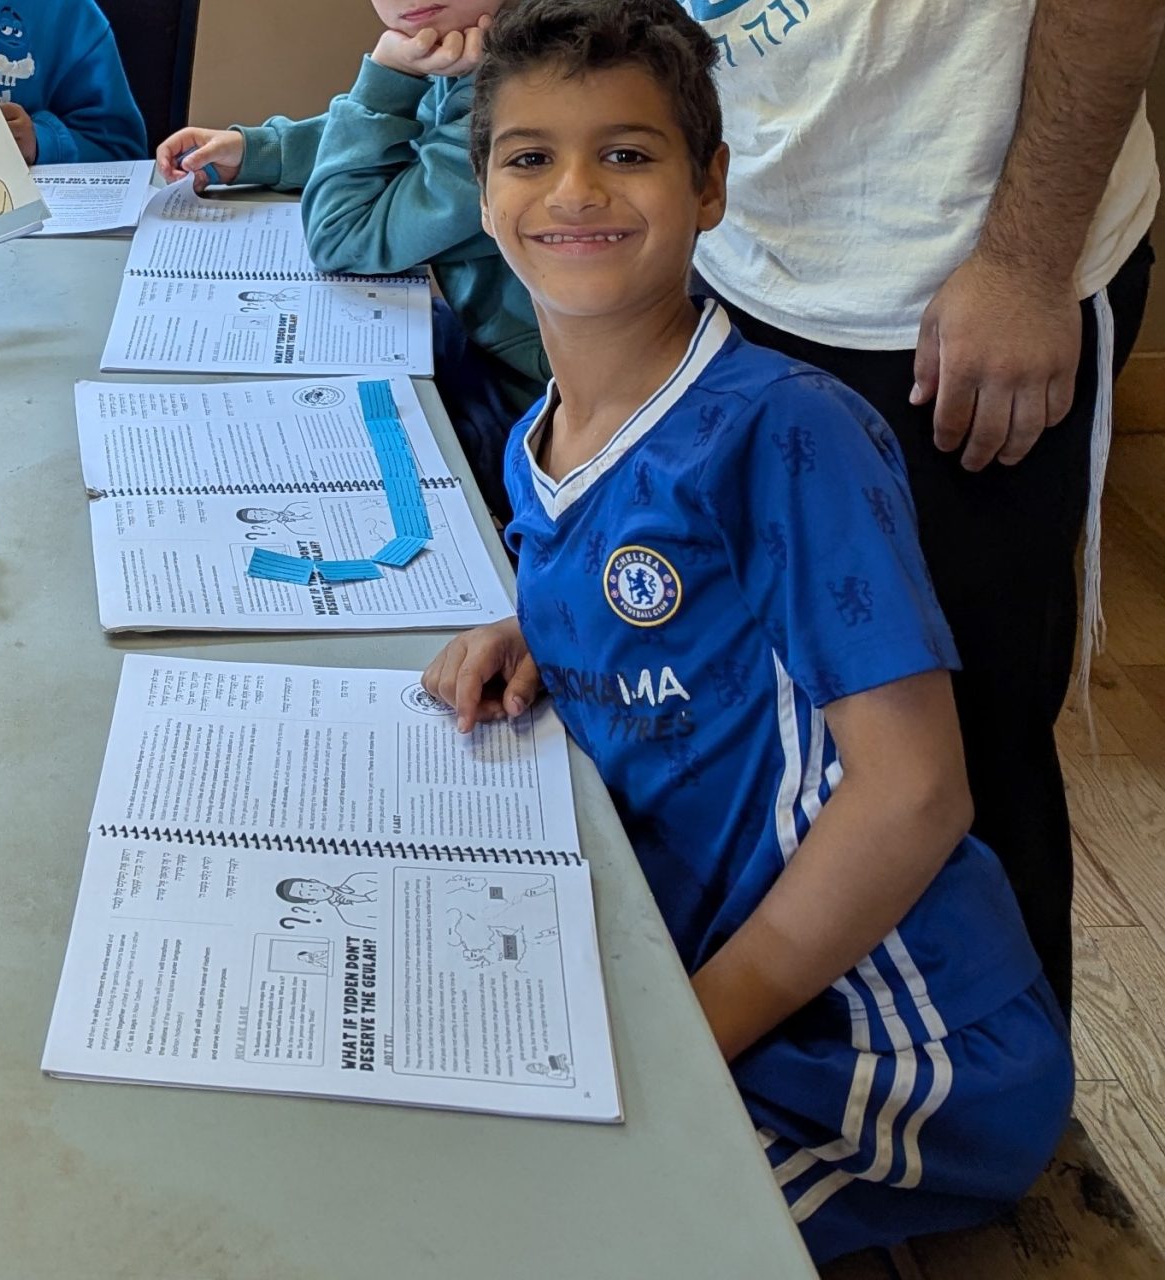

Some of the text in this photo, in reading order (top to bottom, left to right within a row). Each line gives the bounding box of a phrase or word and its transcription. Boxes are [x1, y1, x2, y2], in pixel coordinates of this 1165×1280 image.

[287, 334, 296, 343] THE
[274, 350, 284, 364] WHAT
[615, 553, 659, 570] CHELSEA
[311, 596, 327, 615] WHAT
[322, 586, 340, 615] DESERVE
[620, 600, 669, 618] FOOTBALL CLUB
[340, 935, 360, 1069] WHAT IF YIDDEN DON'T
[359, 938, 376, 1071] DESERVE THE GEULAH?
[236, 1027, 246, 1040] AGE
[235, 1043, 245, 1059] NEW
[383, 1050, 392, 1065] NOT
